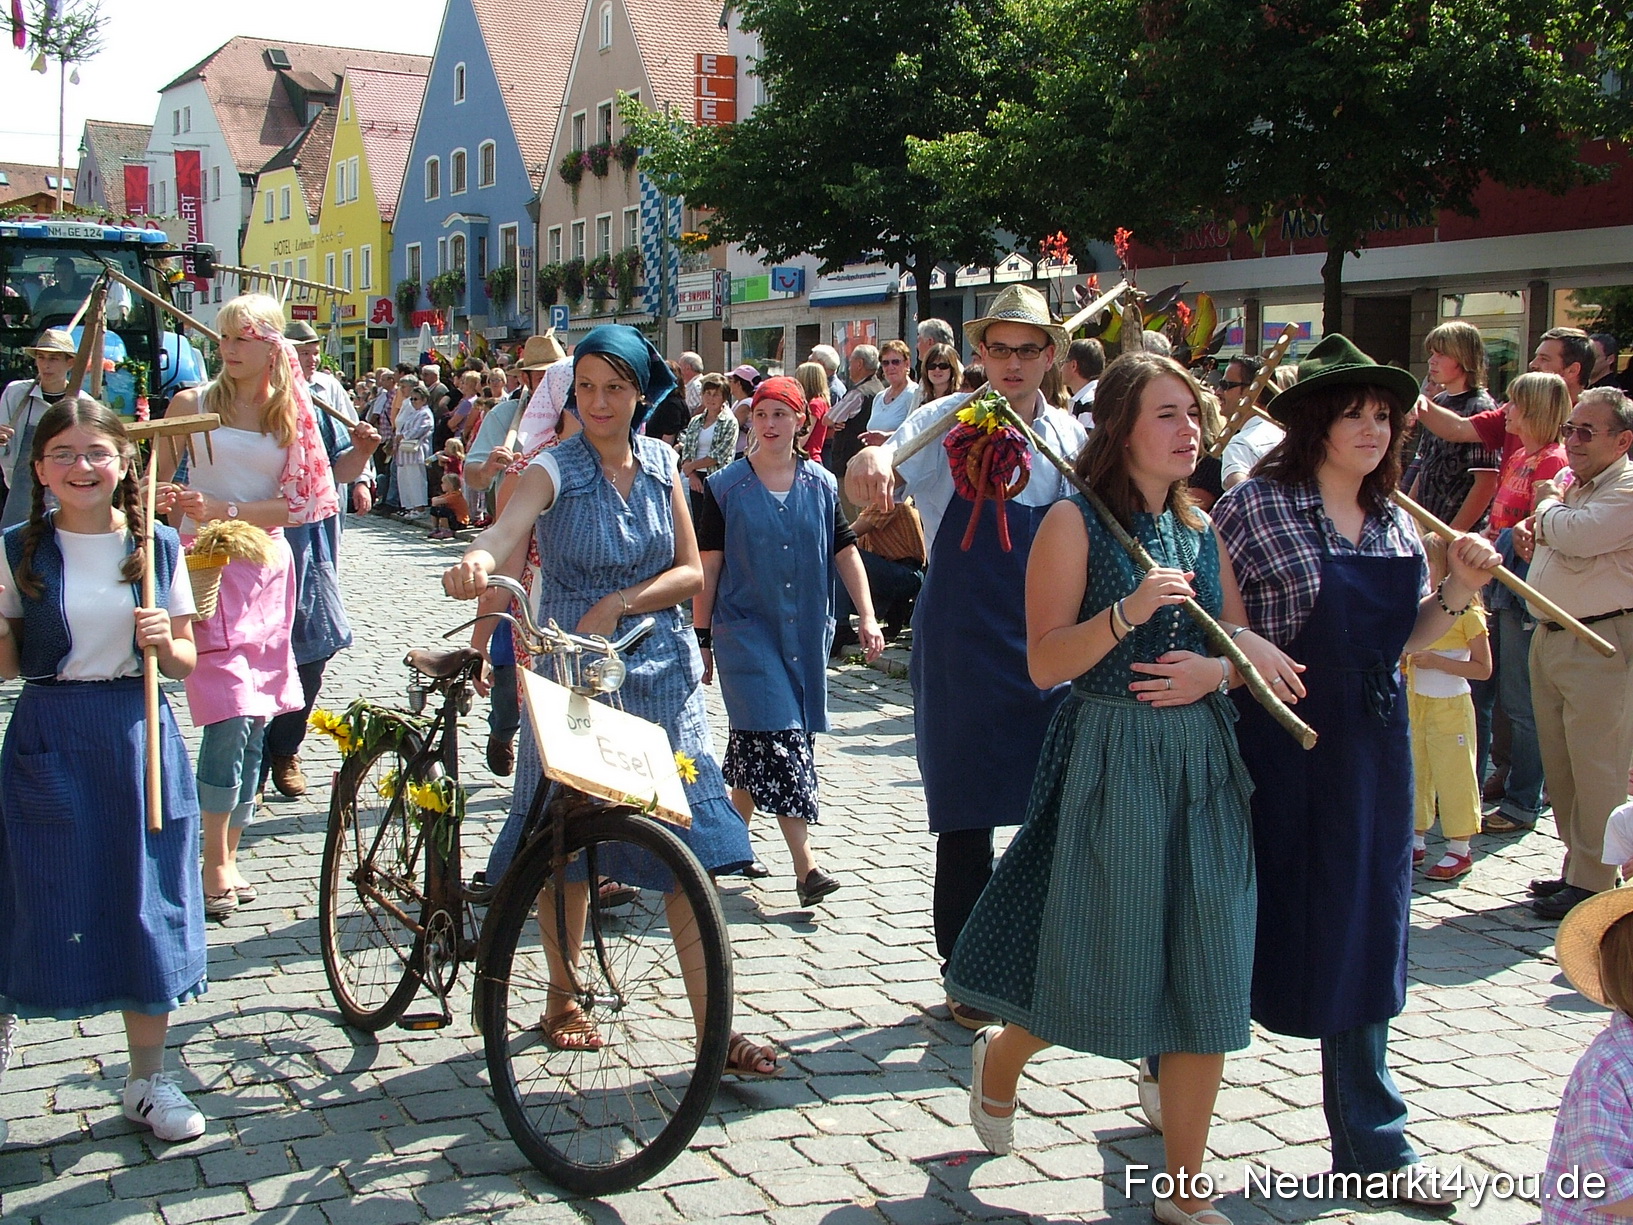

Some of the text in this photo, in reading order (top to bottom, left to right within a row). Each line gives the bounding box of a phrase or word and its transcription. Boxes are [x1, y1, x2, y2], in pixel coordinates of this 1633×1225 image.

[701, 54, 717, 126] ELE
[49, 226, 103, 238] NM GE 124
[273, 239, 292, 256] HOTEL
[554, 308, 564, 328] P
[596, 735, 655, 780] Esel
